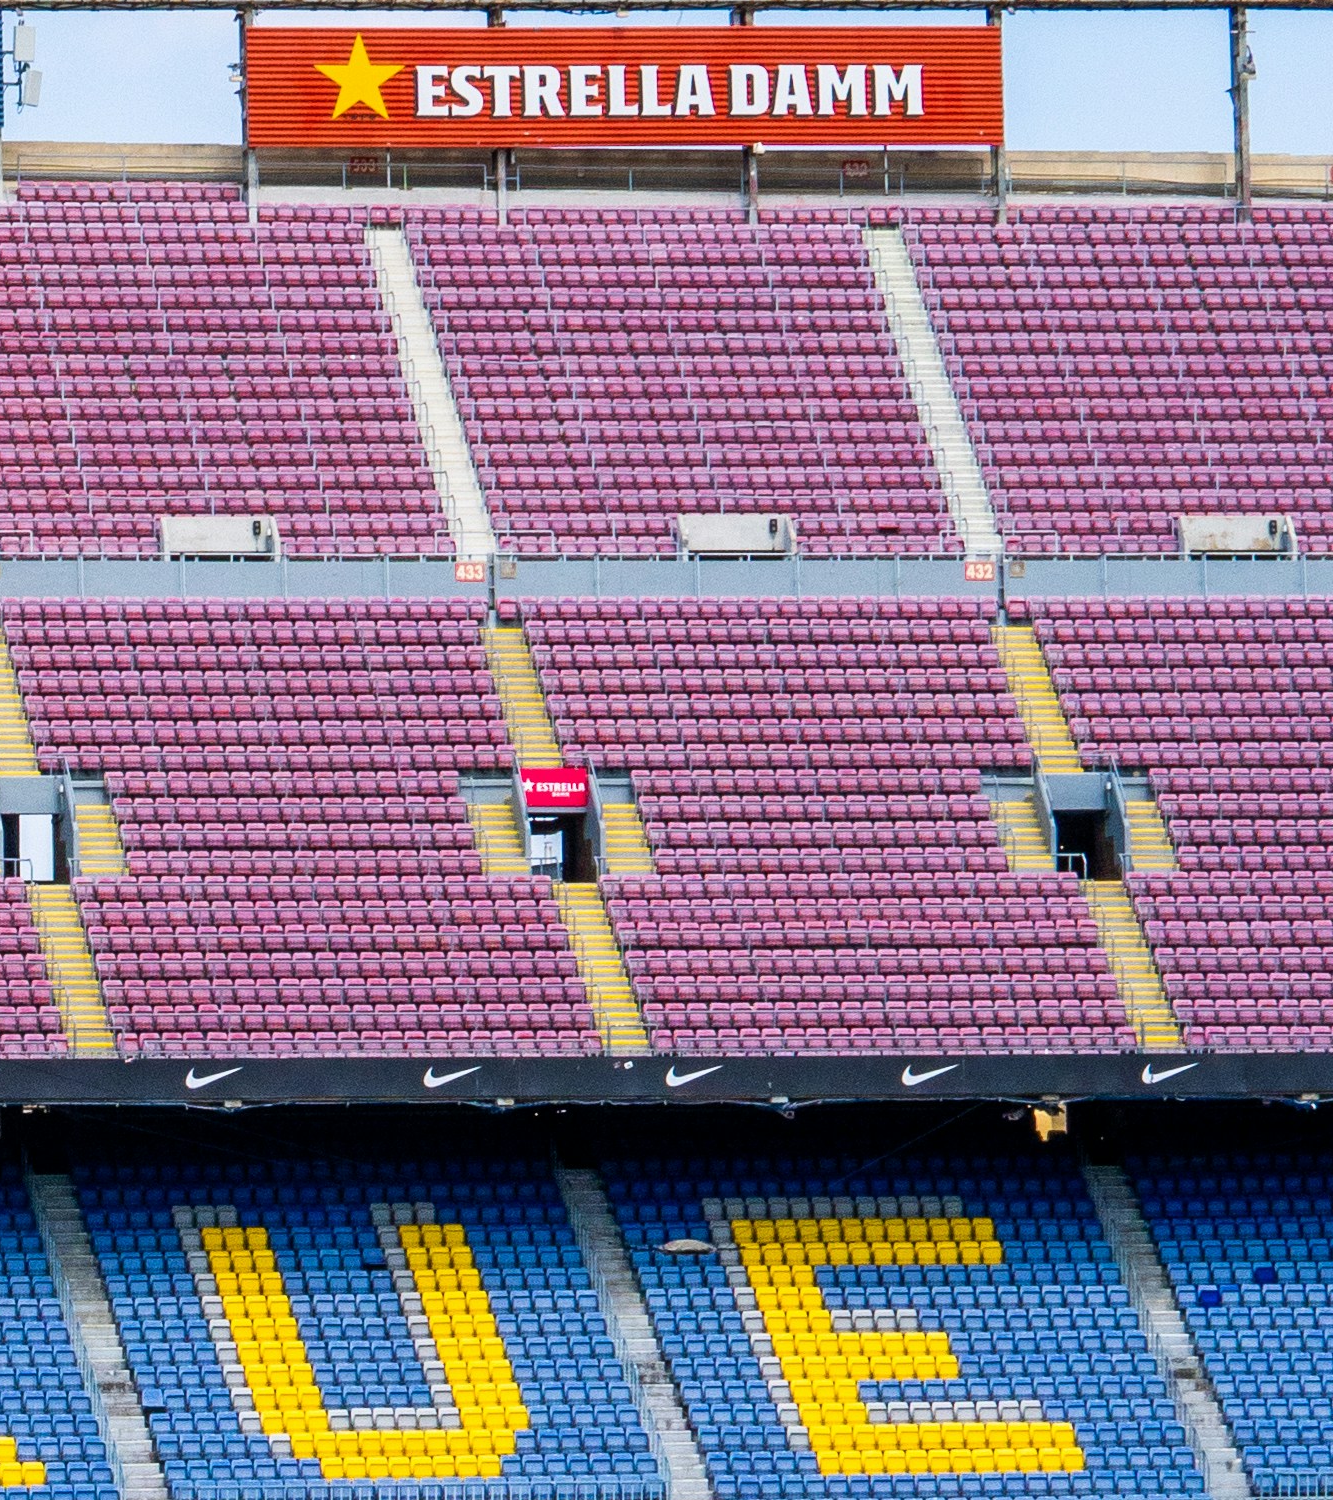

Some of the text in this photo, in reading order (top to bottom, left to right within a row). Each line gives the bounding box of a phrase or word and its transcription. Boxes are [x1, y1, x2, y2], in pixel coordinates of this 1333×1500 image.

[415, 63, 926, 117] ESTRELLA DAMM
[456, 564, 484, 579] 433
[965, 564, 993, 579] 432
[536, 782, 586, 792] ESTRELLA
